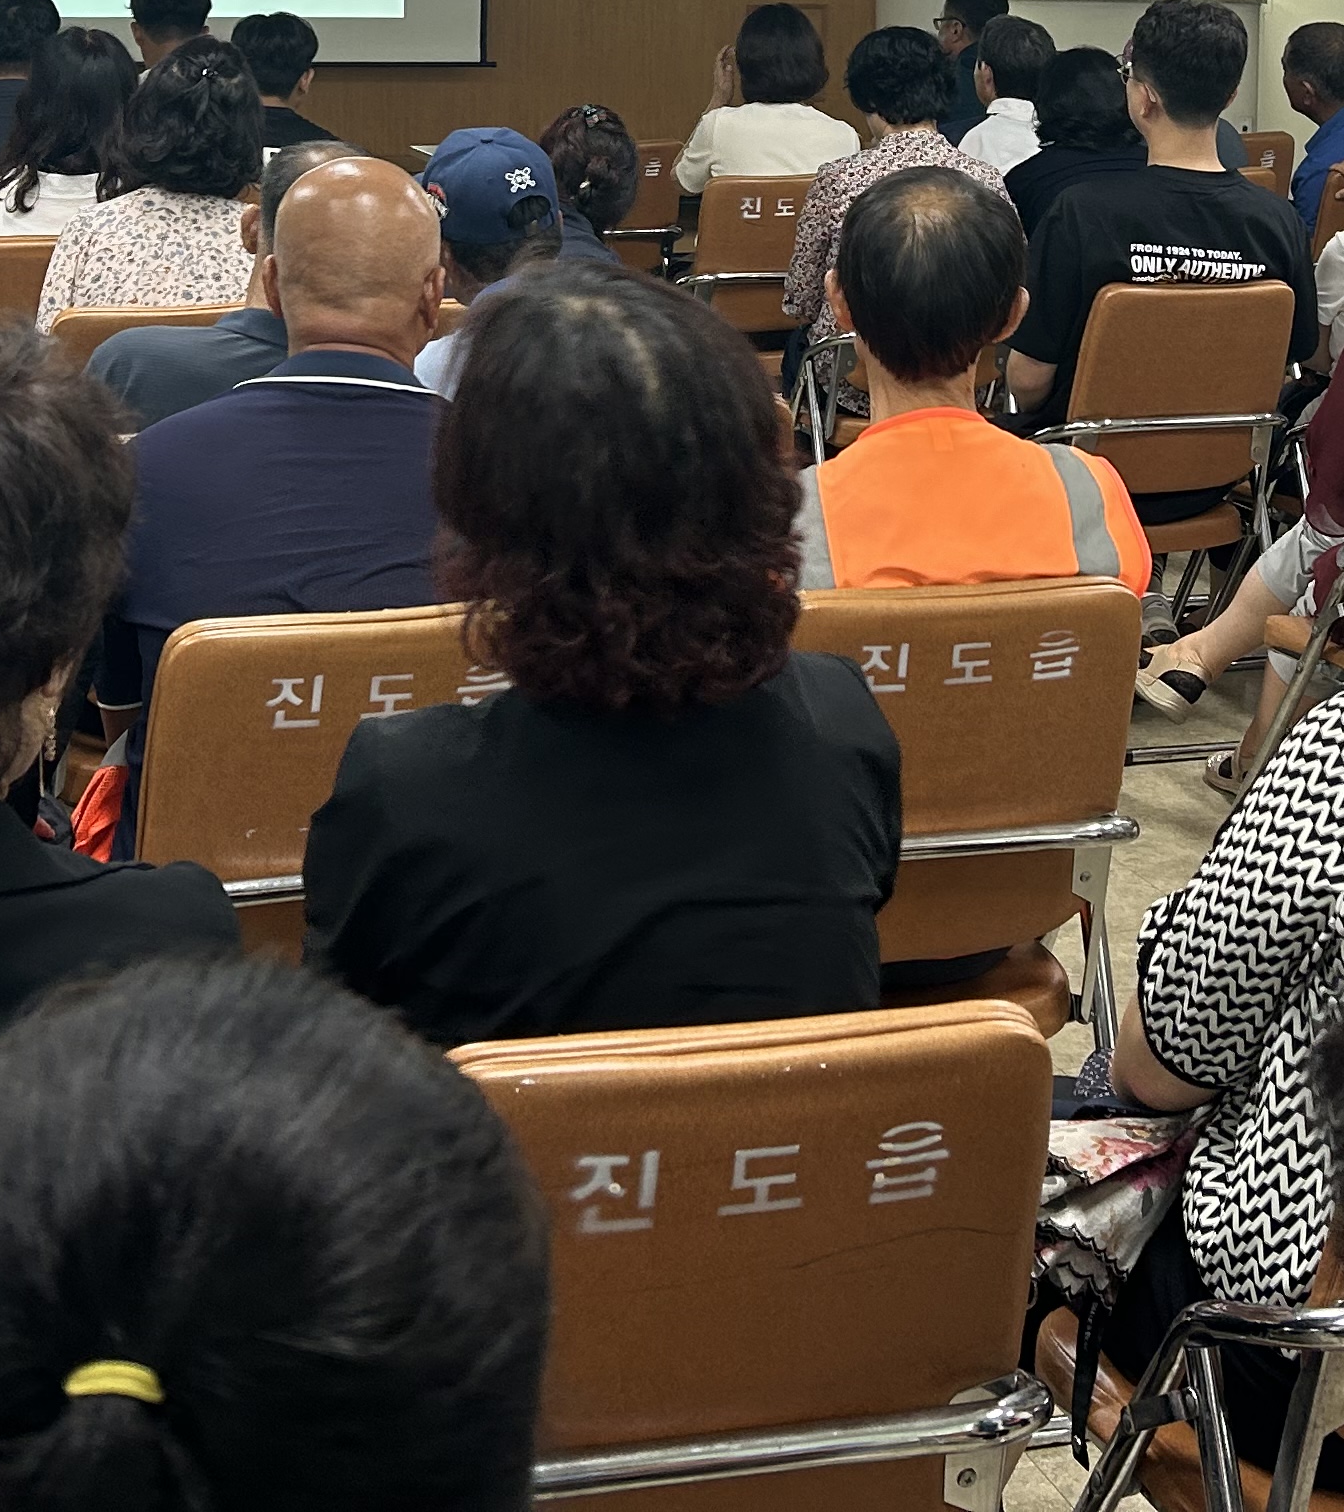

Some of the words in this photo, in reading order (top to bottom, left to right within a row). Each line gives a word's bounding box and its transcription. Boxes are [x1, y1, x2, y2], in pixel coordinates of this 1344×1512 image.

[740, 196, 796, 219] 진도
[1130, 243, 1163, 254] FROM
[1192, 248, 1206, 258] TO
[1207, 249, 1243, 261] TODAY.
[1131, 255, 1178, 274] ONLY
[861, 629, 1080, 693] 진도읍
[570, 1121, 950, 1235] 진도읍
